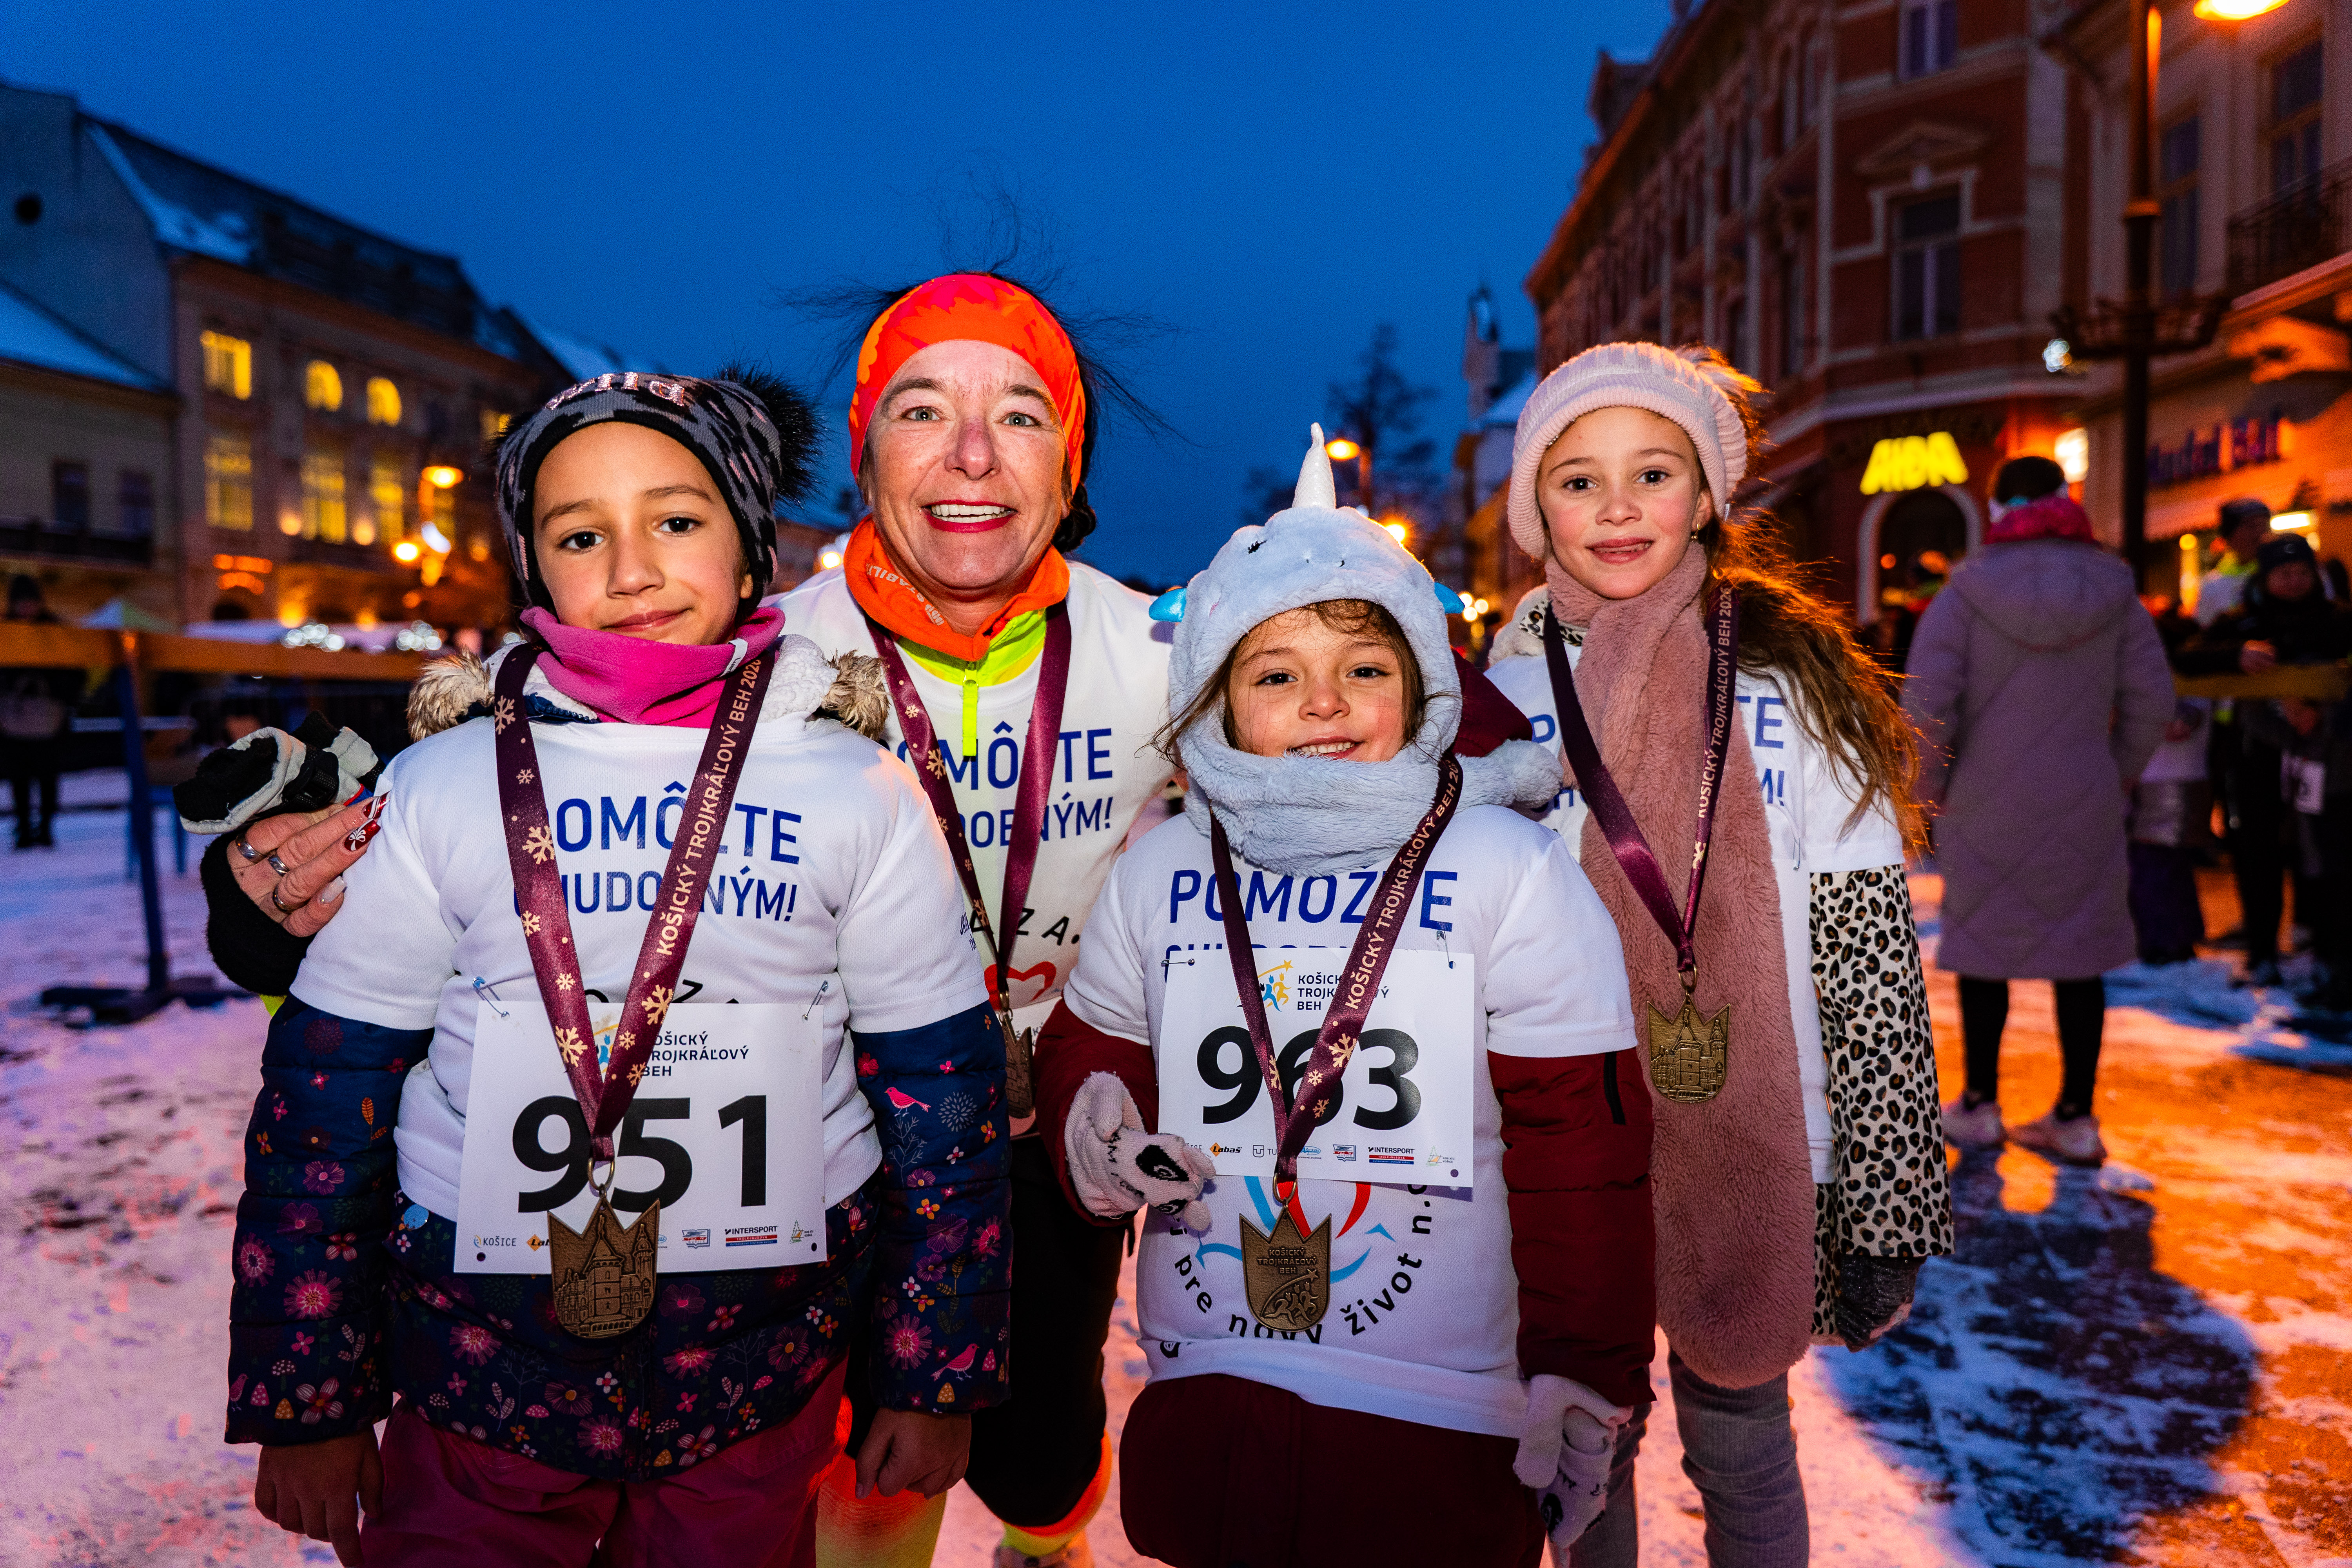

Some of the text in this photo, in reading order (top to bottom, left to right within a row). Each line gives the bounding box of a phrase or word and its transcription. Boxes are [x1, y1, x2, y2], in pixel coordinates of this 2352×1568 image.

[1718, 619, 1731, 646] BEH
[1711, 649, 1731, 746] TROJKRÁĽOVÝ
[657, 863, 697, 956] KOŠICKÝ
[685, 722, 740, 859] TROJKRÁĽOVÝ
[729, 689, 752, 722] BEH
[1345, 931, 1384, 1009] KOŠICKÝ
[1376, 816, 1436, 928] TROJKRÁĽOVÝ
[1435, 783, 1456, 818] BEH
[1298, 972, 1342, 984] KOŠICK
[1297, 1001, 1321, 1010] BEH
[655, 1031, 708, 1045] OŠICKÝ
[652, 1045, 749, 1063] ROJKRÁĽOVÝ
[643, 1065, 671, 1076] BEH
[1197, 1026, 1421, 1130] 963
[512, 1095, 766, 1213] 951
[732, 1226, 777, 1234] INTERSPORT
[483, 1236, 517, 1247] KOŠICE
[1269, 1247, 1306, 1256] KOŠICKÝ
[1257, 1256, 1317, 1266] TROJKRÁĽOVÝ
[1174, 1254, 1212, 1313] pre
[1339, 1252, 1422, 1336] život
